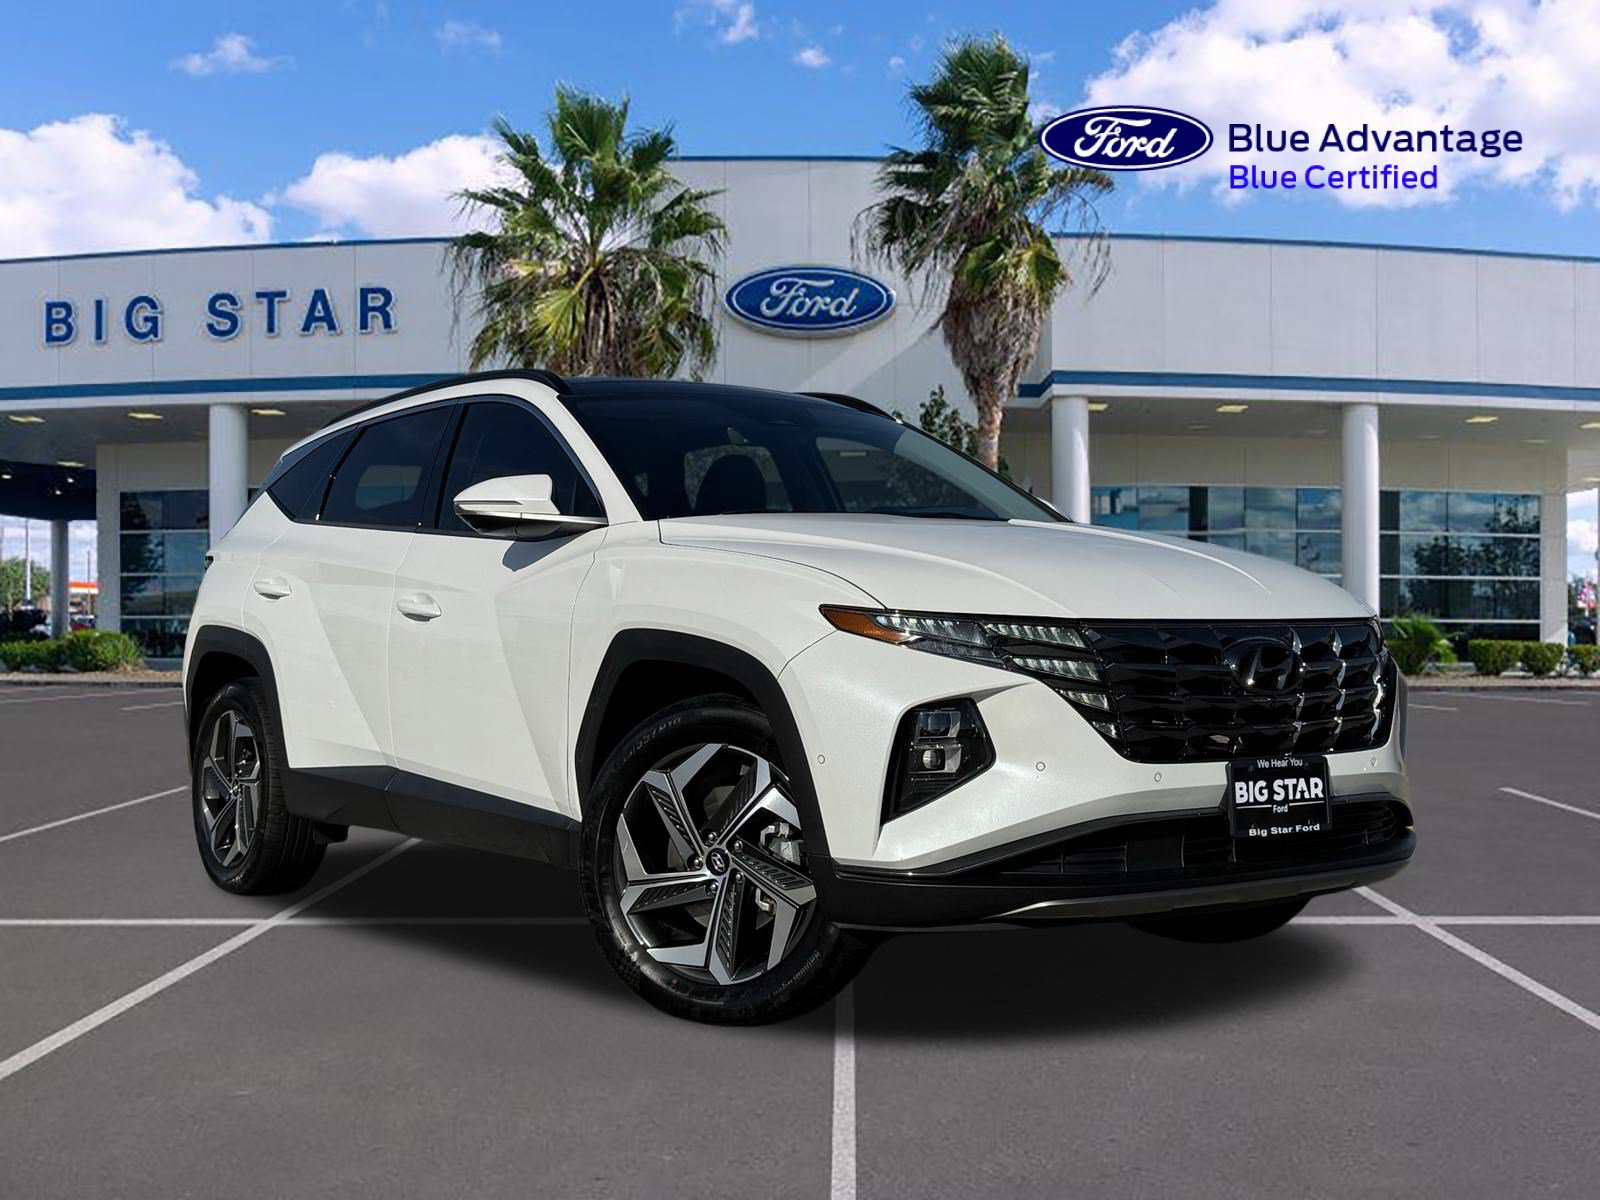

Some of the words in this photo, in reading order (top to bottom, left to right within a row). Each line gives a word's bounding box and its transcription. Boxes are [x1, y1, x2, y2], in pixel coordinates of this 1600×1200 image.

[760, 277, 858, 317] Ford
[44, 295, 163, 345] BIG
[205, 286, 398, 341] STAR
[1257, 759, 1270, 768] We
[1271, 758, 1289, 768] Hear
[1290, 757, 1303, 767] You
[1234, 780, 1269, 804] BIG
[1272, 777, 1325, 801] STAR
[1272, 804, 1288, 813] Ford
[1248, 827, 1268, 837] Big
[1270, 825, 1293, 835] Star
[1295, 823, 1320, 833] Ford
